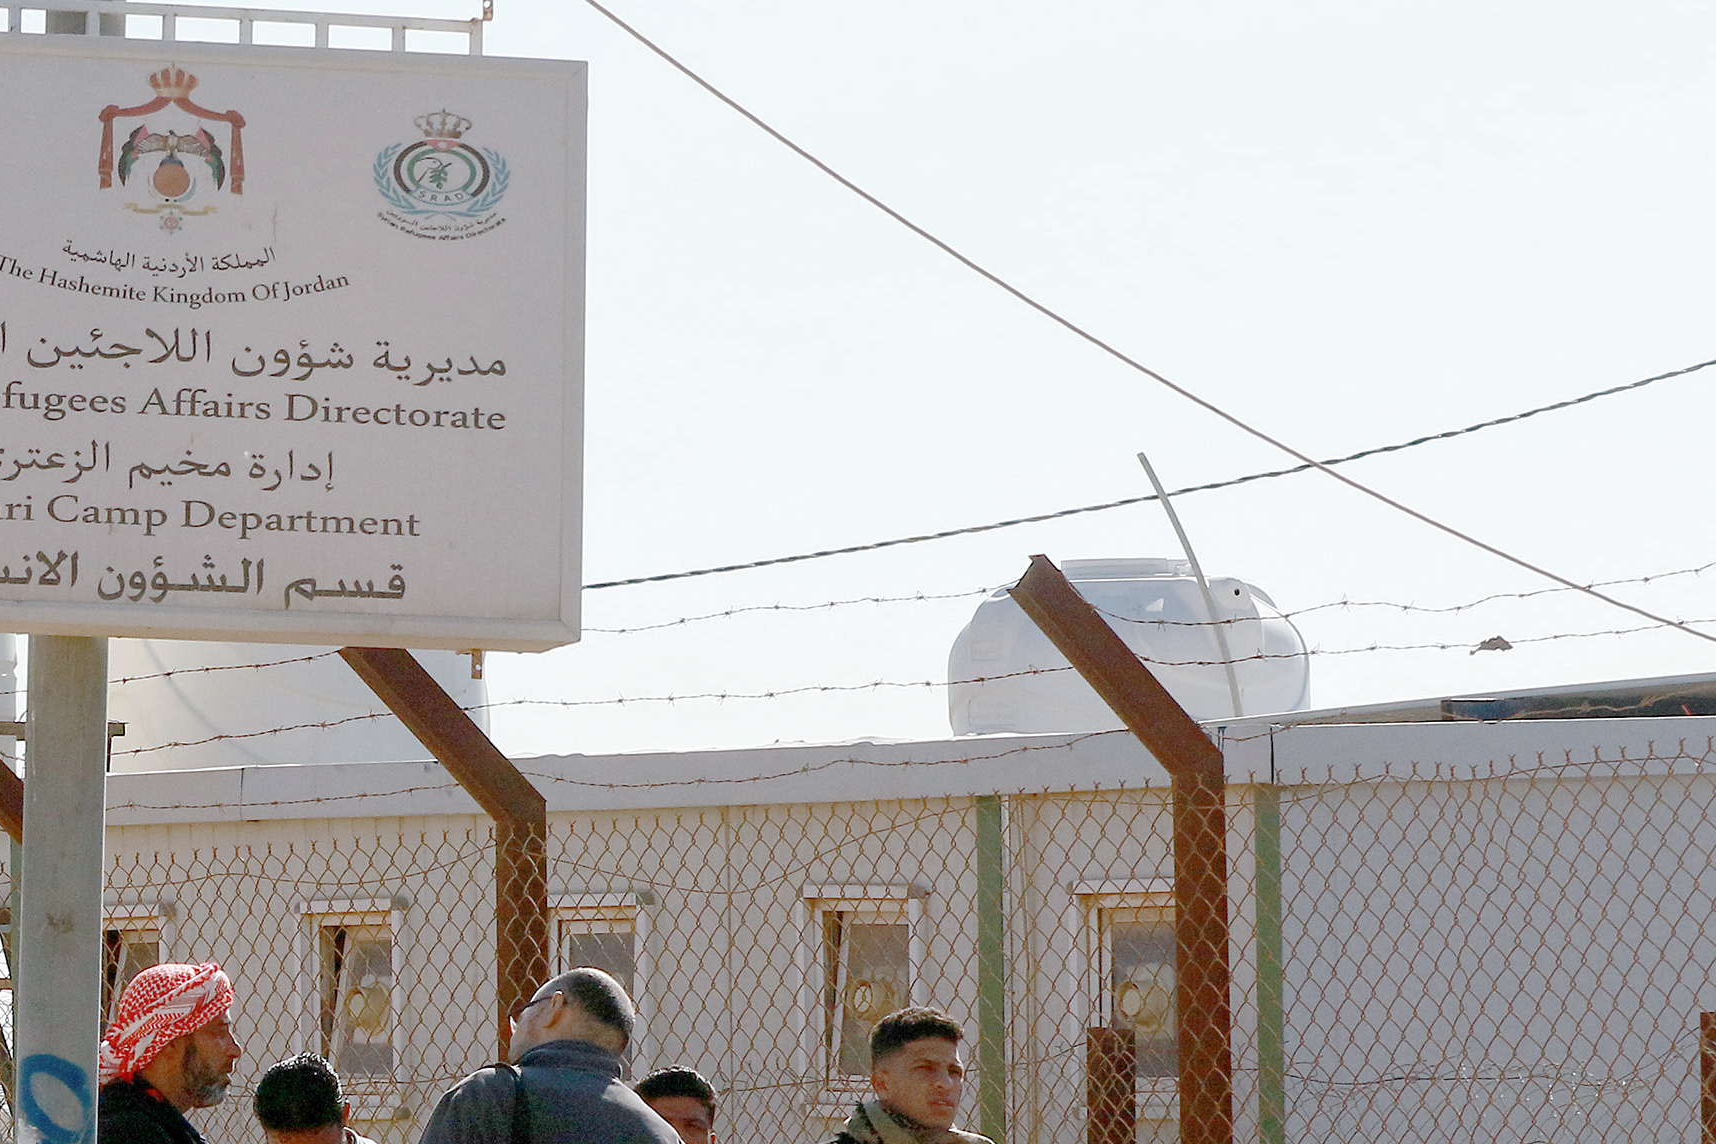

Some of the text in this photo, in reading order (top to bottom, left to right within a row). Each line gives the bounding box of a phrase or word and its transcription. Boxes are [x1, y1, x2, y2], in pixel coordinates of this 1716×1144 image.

[417, 189, 465, 203] SRAD
[62, 238, 276, 279] المملكة الأردنية الهاشمية
[37, 267, 147, 302] Hashemite
[152, 285, 247, 310] Kingdom
[251, 281, 280, 301] Of
[282, 274, 351, 302] Jordan
[26, 326, 211, 370] اللاجئين
[231, 339, 354, 382] شؤون
[372, 340, 507, 387] مديرية
[136, 387, 272, 421] Affairs
[283, 393, 506, 431] Directorate
[128, 449, 232, 490] مخيم
[248, 449, 335, 493] إدارة
[46, 494, 168, 537] Camp
[180, 499, 421, 541] Department
[97, 553, 265, 604] الشؤون
[283, 563, 406, 611] قسم
